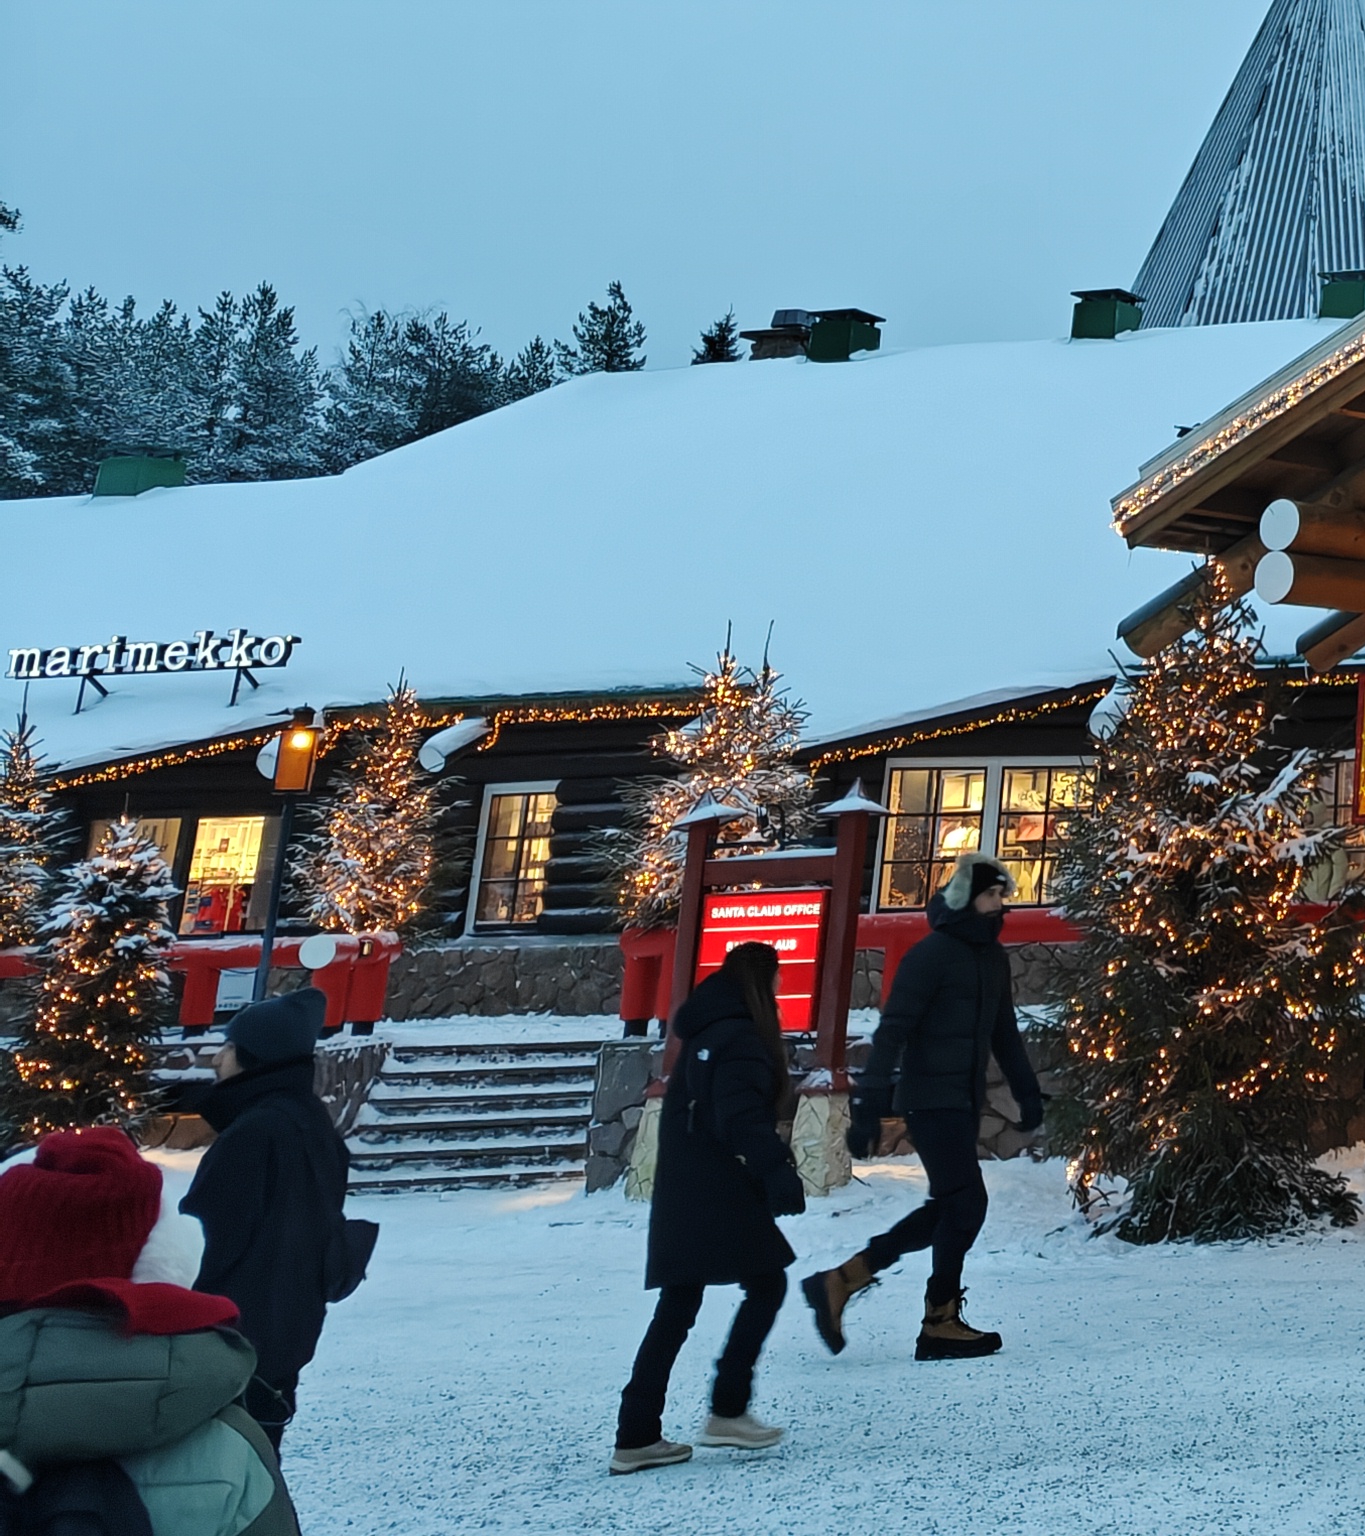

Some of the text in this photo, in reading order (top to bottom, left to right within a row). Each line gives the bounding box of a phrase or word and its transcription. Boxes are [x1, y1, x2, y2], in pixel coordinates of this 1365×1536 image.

[5, 628, 296, 678] marimekko
[711, 903, 821, 919] SANTA CLAUS OFFICE
